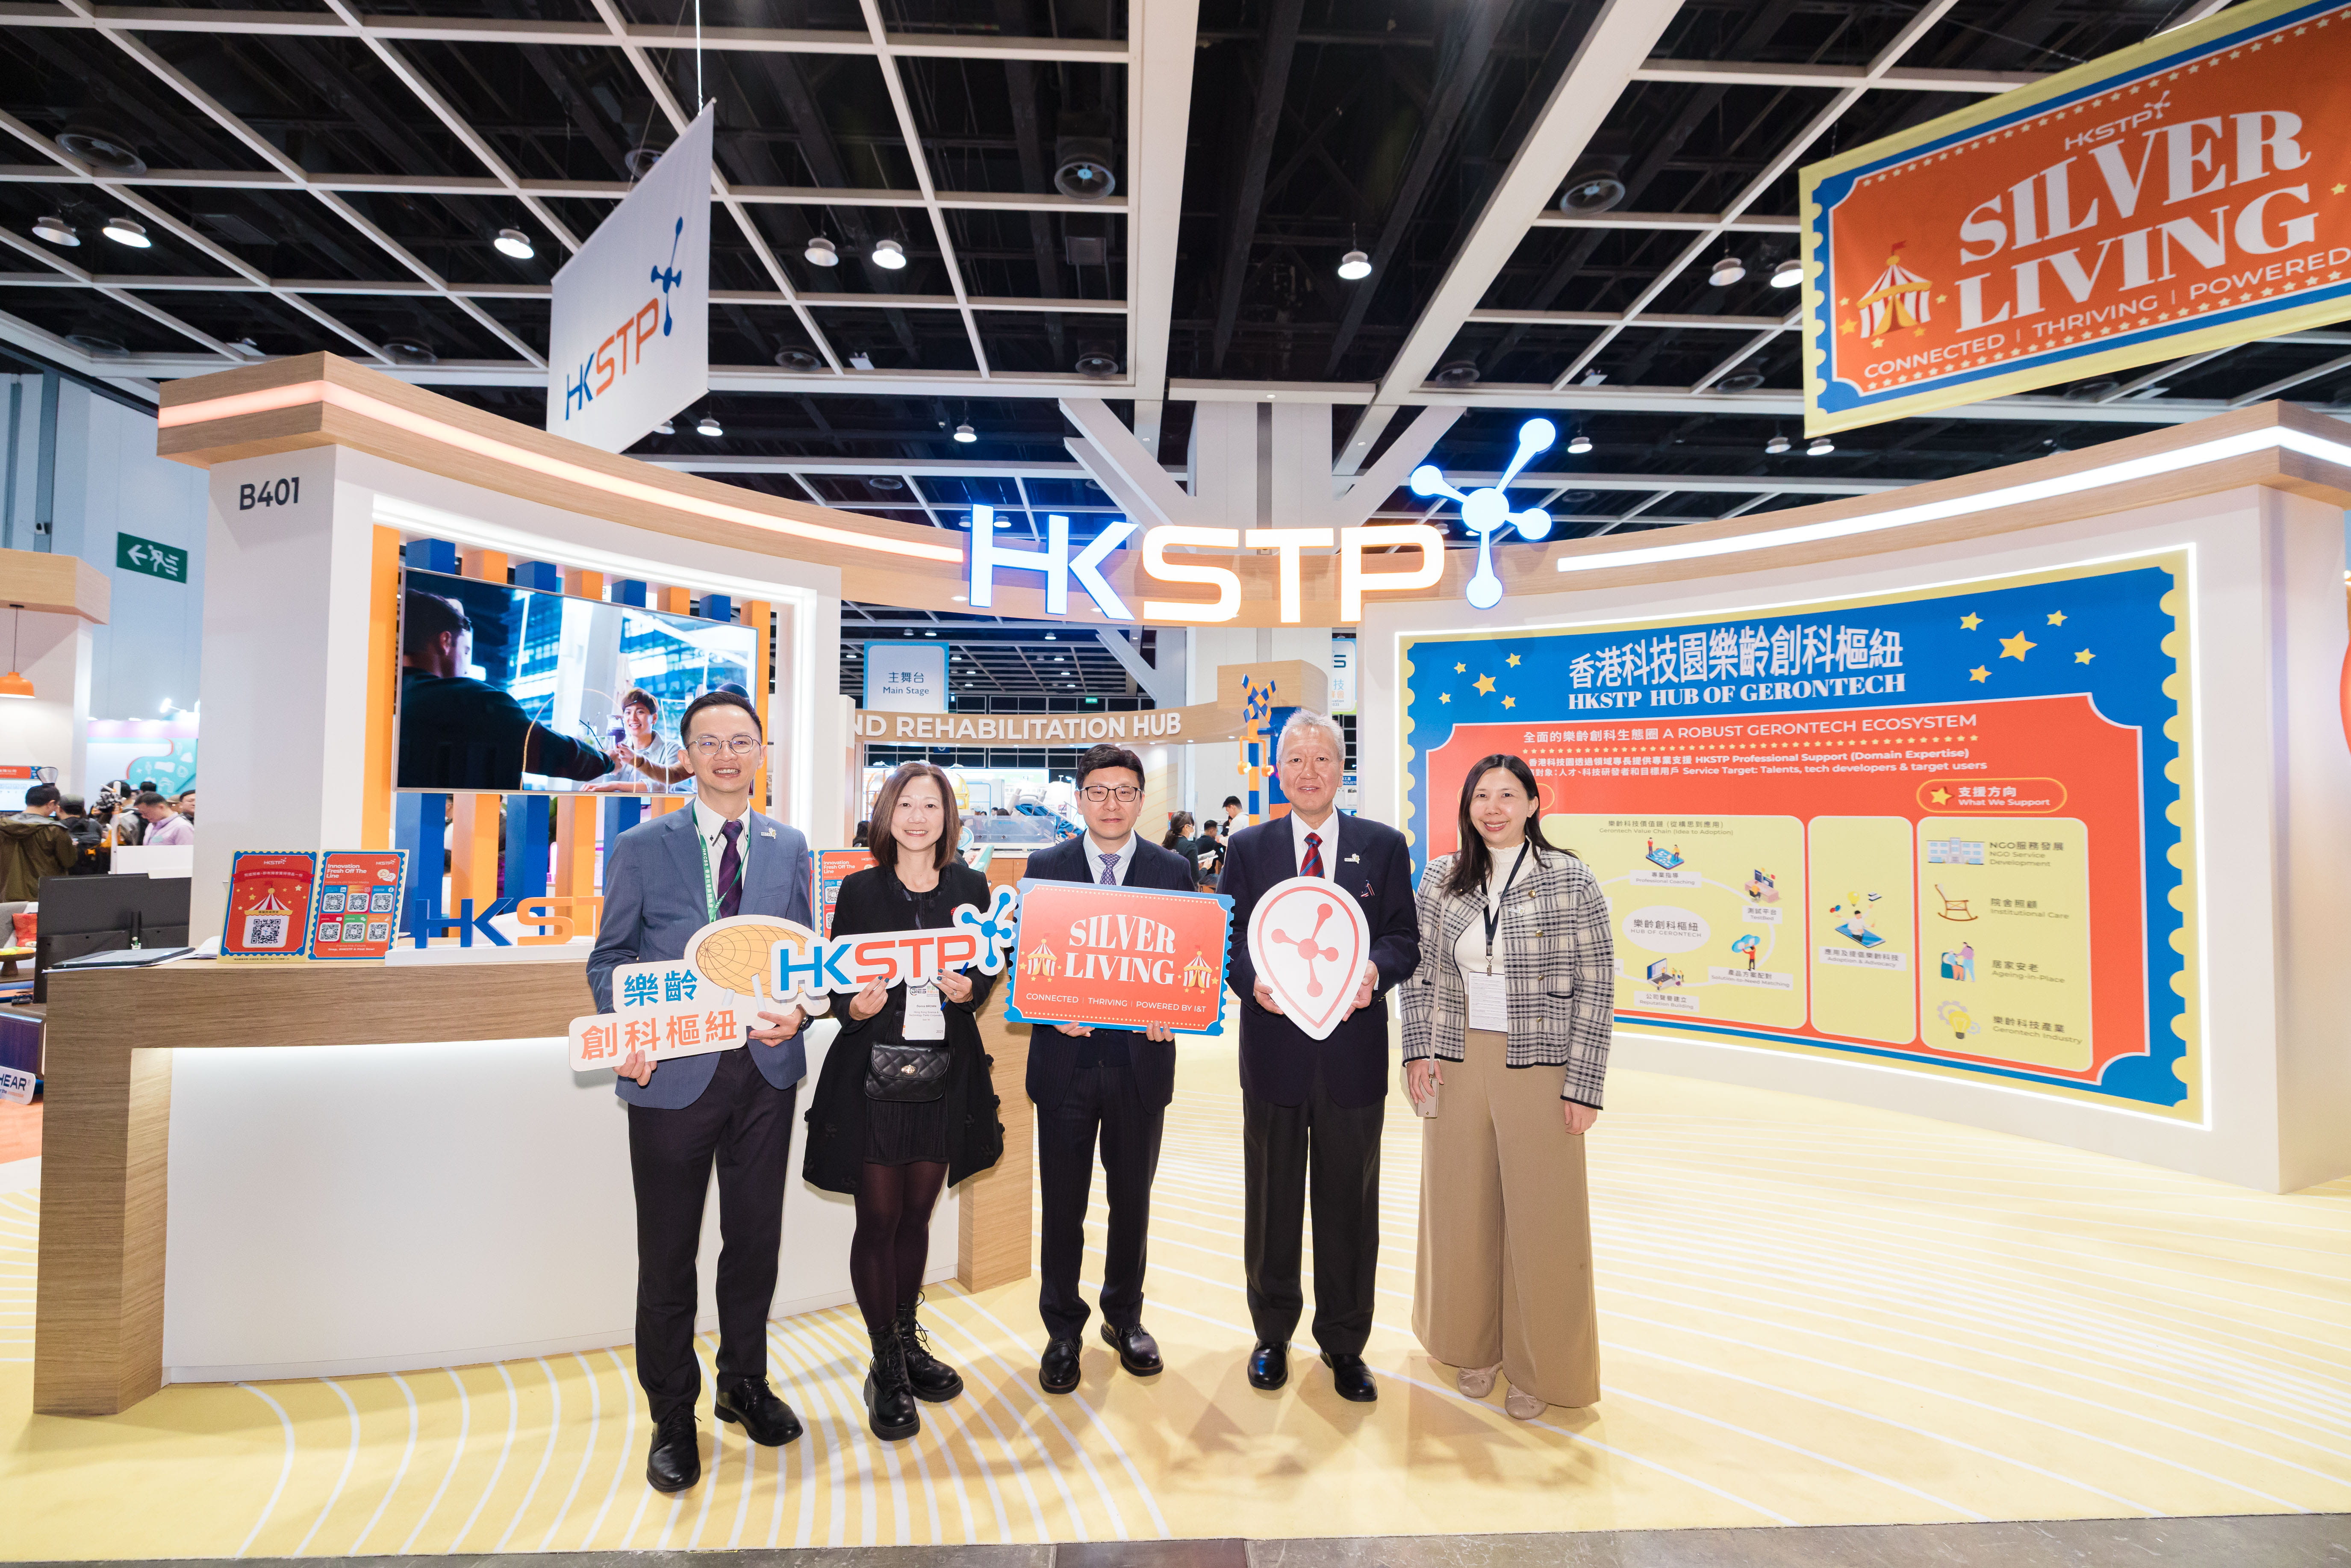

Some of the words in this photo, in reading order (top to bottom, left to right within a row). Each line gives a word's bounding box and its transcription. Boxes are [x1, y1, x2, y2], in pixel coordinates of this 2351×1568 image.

[2064, 110, 2153, 151] HKSTP
[1959, 109, 2312, 266] SILVER
[1954, 183, 2319, 334] LIVING
[1863, 333, 2006, 380] CONNECTED
[2032, 295, 2159, 339] THRIVING
[2189, 247, 2351, 301] POWERED
[566, 298, 659, 421] HKSTP
[239, 477, 300, 510] B401
[969, 503, 1445, 624] HKSTP
[1569, 624, 1903, 689] 香港科技園樂齡創科樞紐
[888, 672, 925, 683] 主舞台
[906, 687, 929, 696] Stage
[1568, 691, 1642, 710] HKSTP
[1650, 687, 1699, 707] HUB
[1703, 686, 1736, 704] OF
[1740, 673, 1906, 701] GERONTECH
[896, 715, 1125, 740] REHABILITATION
[1133, 712, 1181, 737] HUB
[1524, 728, 1659, 743] 全面的樂齡創科生態圈
[1663, 728, 1674, 739] A
[1678, 725, 1744, 738] ROBUST
[1747, 720, 1856, 736] GERONTECH
[1862, 714, 1977, 731] ECOSYSTEM
[1683, 766, 1720, 775] Service
[1721, 766, 1758, 775] Target:
[1760, 766, 1803, 774] Talents,
[1804, 764, 1830, 773] tech
[1832, 763, 1897, 775] developers
[1911, 762, 1949, 773] target
[1953, 762, 1988, 771] users
[1695, 755, 1729, 764] HKSTP
[1732, 754, 1798, 763] Professional
[1801, 752, 1848, 762] Support
[1850, 750, 1902, 762] (Domain
[1906, 748, 1970, 760] Expertise)
[1958, 786, 2017, 798] 支援方向
[2007, 799, 2050, 807] Support
[1989, 859, 2051, 867] Development
[1990, 908, 2045, 918] Institutional
[1069, 914, 1176, 954] SILVER
[780, 934, 977, 991] HKSTP
[1064, 952, 1175, 985] LIVING
[1827, 955, 1857, 964] Adoption
[1865, 959, 1897, 968] Advocacy
[623, 969, 699, 1008] 樂齡
[1712, 975, 1760, 985] Solution-to-Need
[1762, 980, 1790, 988] Matching
[1992, 970, 2065, 984] Ageing-in-Place
[1026, 993, 1079, 1004] CONNECTED
[1087, 997, 1128, 1007] THRIVING
[1136, 1000, 1179, 1011] POWERED
[1181, 1004, 1192, 1012] BY
[1194, 1004, 1206, 1013] I&T
[581, 1009, 738, 1060] 創科樞紐
[1993, 1026, 2041, 1038] Gerontech
[2042, 1031, 2083, 1044] Industry
